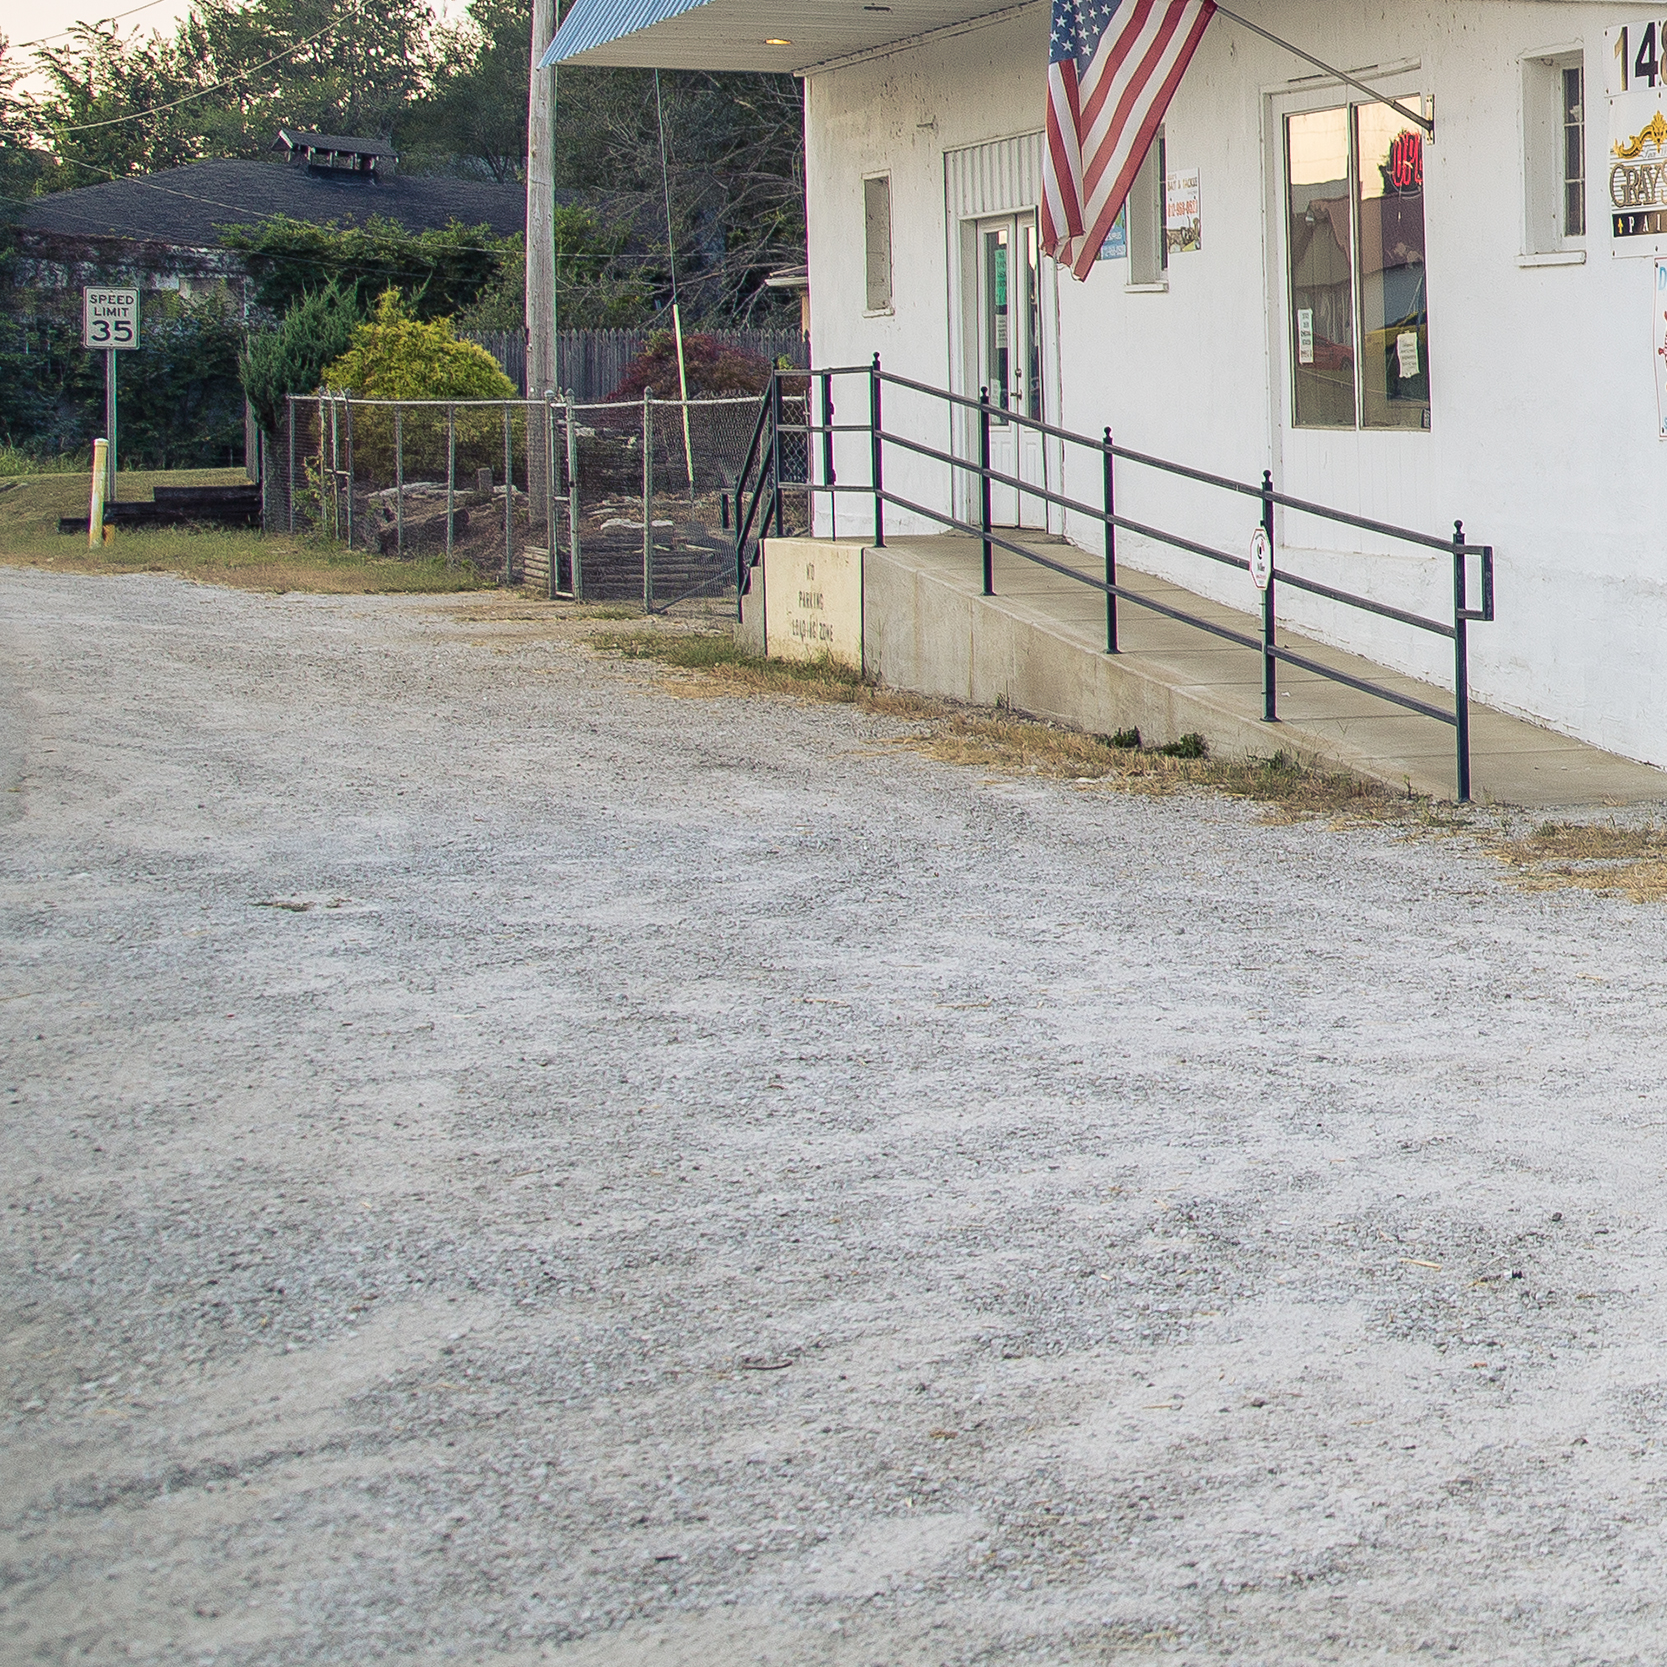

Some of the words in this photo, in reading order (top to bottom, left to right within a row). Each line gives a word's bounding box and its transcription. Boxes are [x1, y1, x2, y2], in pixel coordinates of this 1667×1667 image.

[90, 294, 134, 304] SPEED
[94, 307, 129, 317] LIMIT
[91, 320, 133, 342] 35
[799, 590, 824, 610] PARKING
